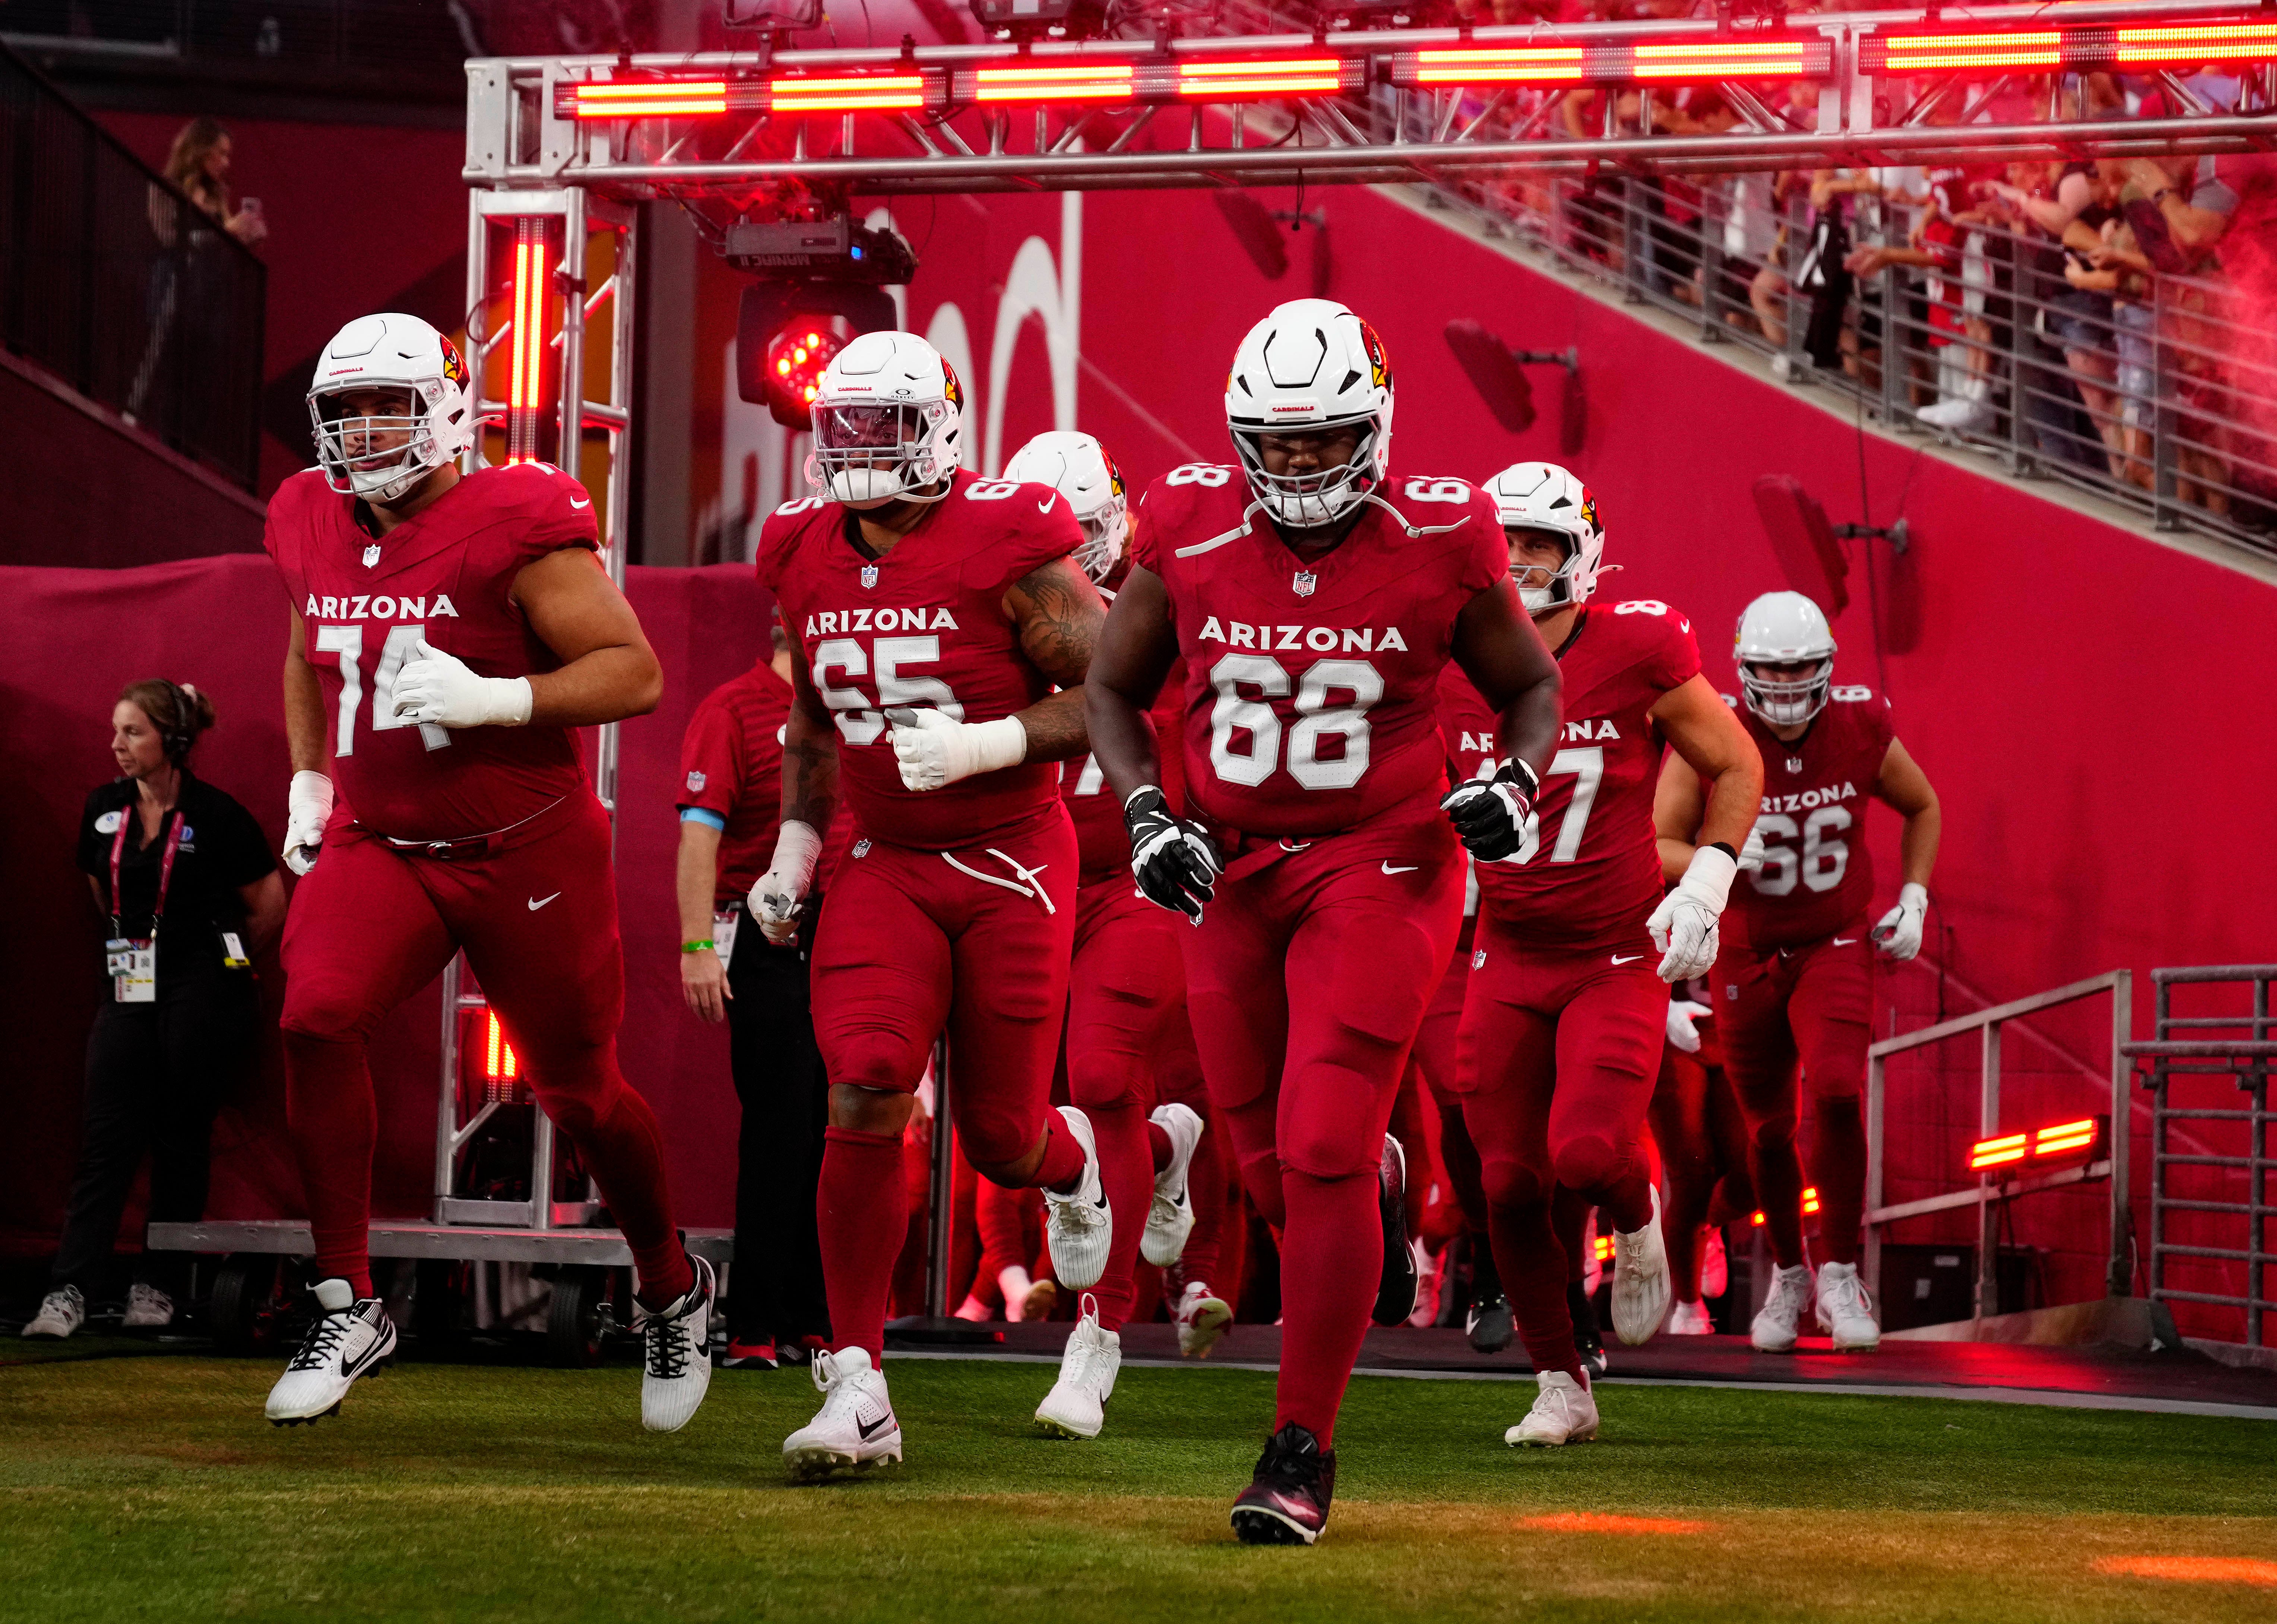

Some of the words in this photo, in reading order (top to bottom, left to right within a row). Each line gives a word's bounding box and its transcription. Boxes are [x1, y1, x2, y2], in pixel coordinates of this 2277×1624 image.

[329, 367, 363, 376] CARDINALS
[1297, 582, 1311, 592] NFL
[305, 593, 459, 620] ARIZONA
[805, 607, 960, 638] ARIZONA
[1198, 615, 1409, 652] ARIZONA
[813, 635, 965, 746] 65
[1209, 652, 1385, 791] 68
[1759, 781, 1858, 813] RIZONA
[1748, 804, 1853, 896] 66
